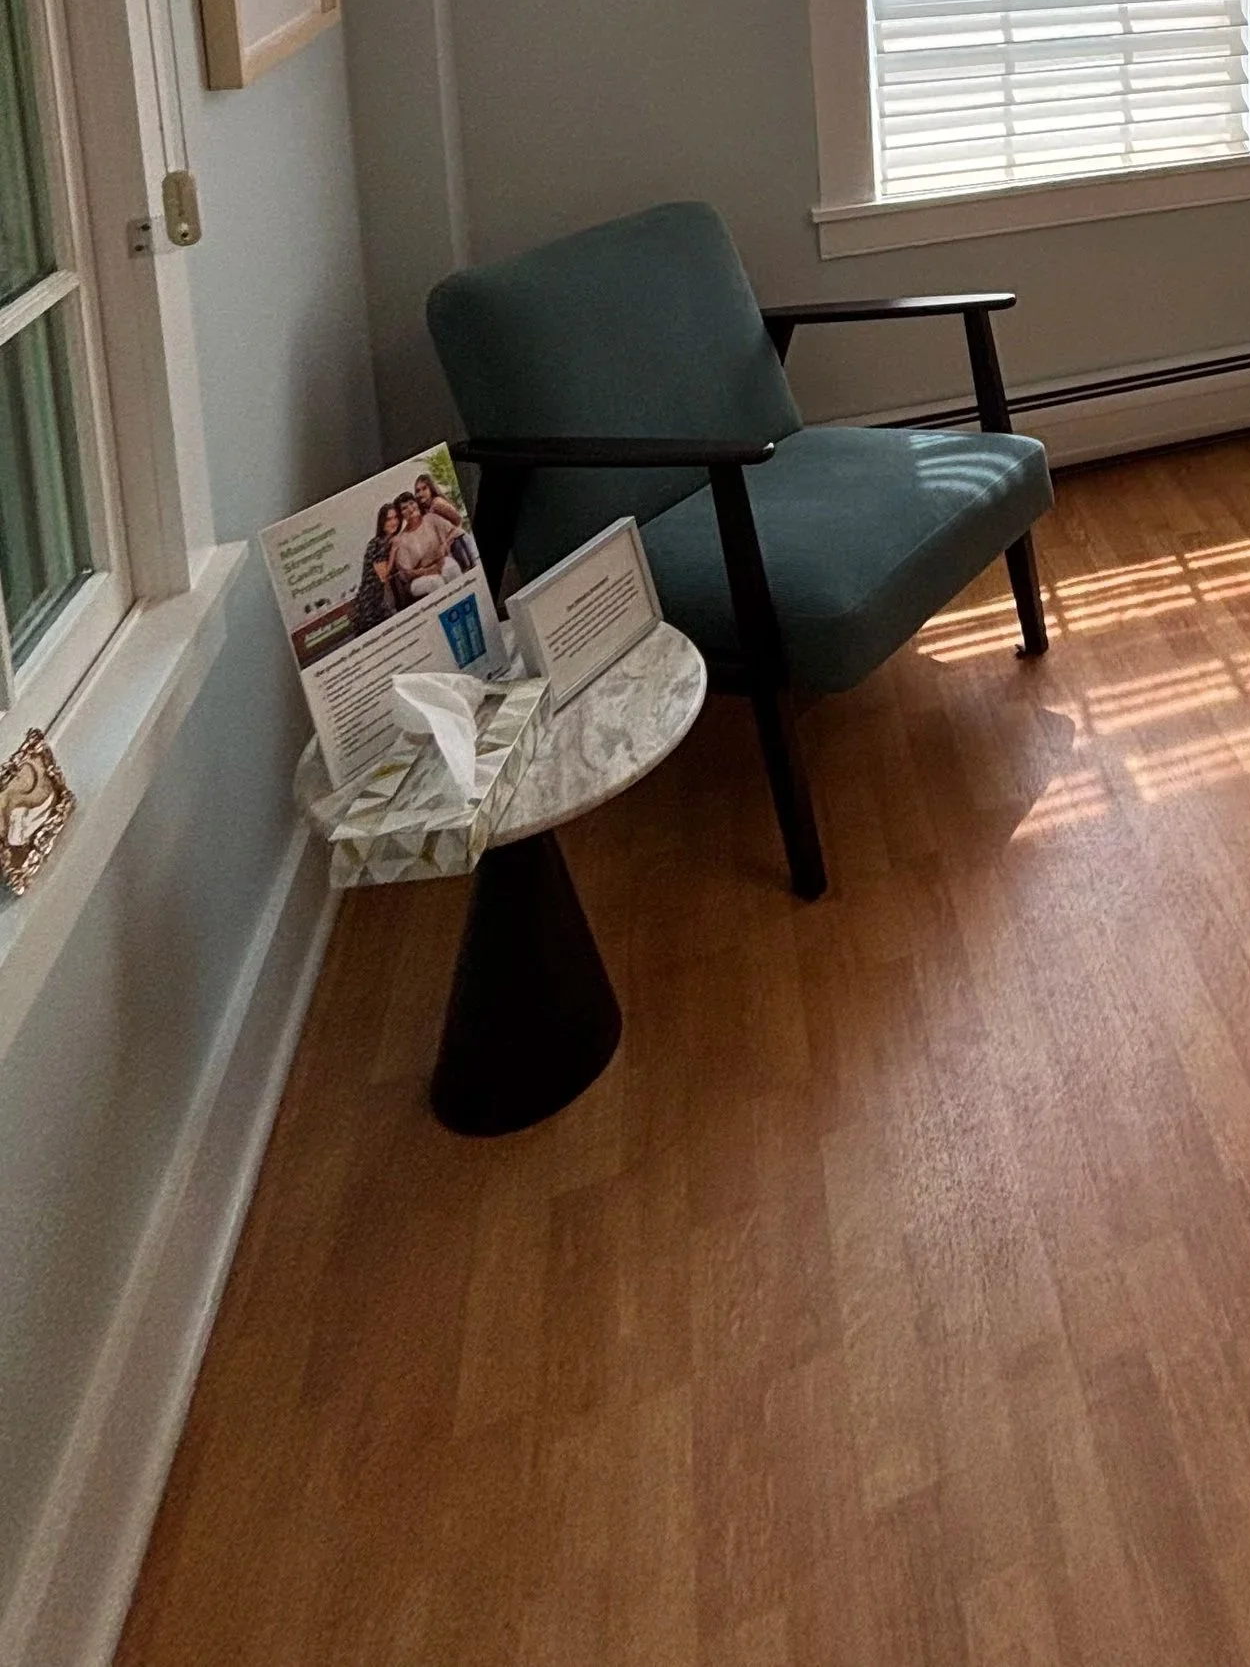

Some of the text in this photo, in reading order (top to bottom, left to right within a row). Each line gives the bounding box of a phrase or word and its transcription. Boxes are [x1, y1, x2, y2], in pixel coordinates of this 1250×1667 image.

[282, 540, 335, 574] Strength
[288, 562, 325, 586] Cavity
[291, 563, 350, 599] Protection
